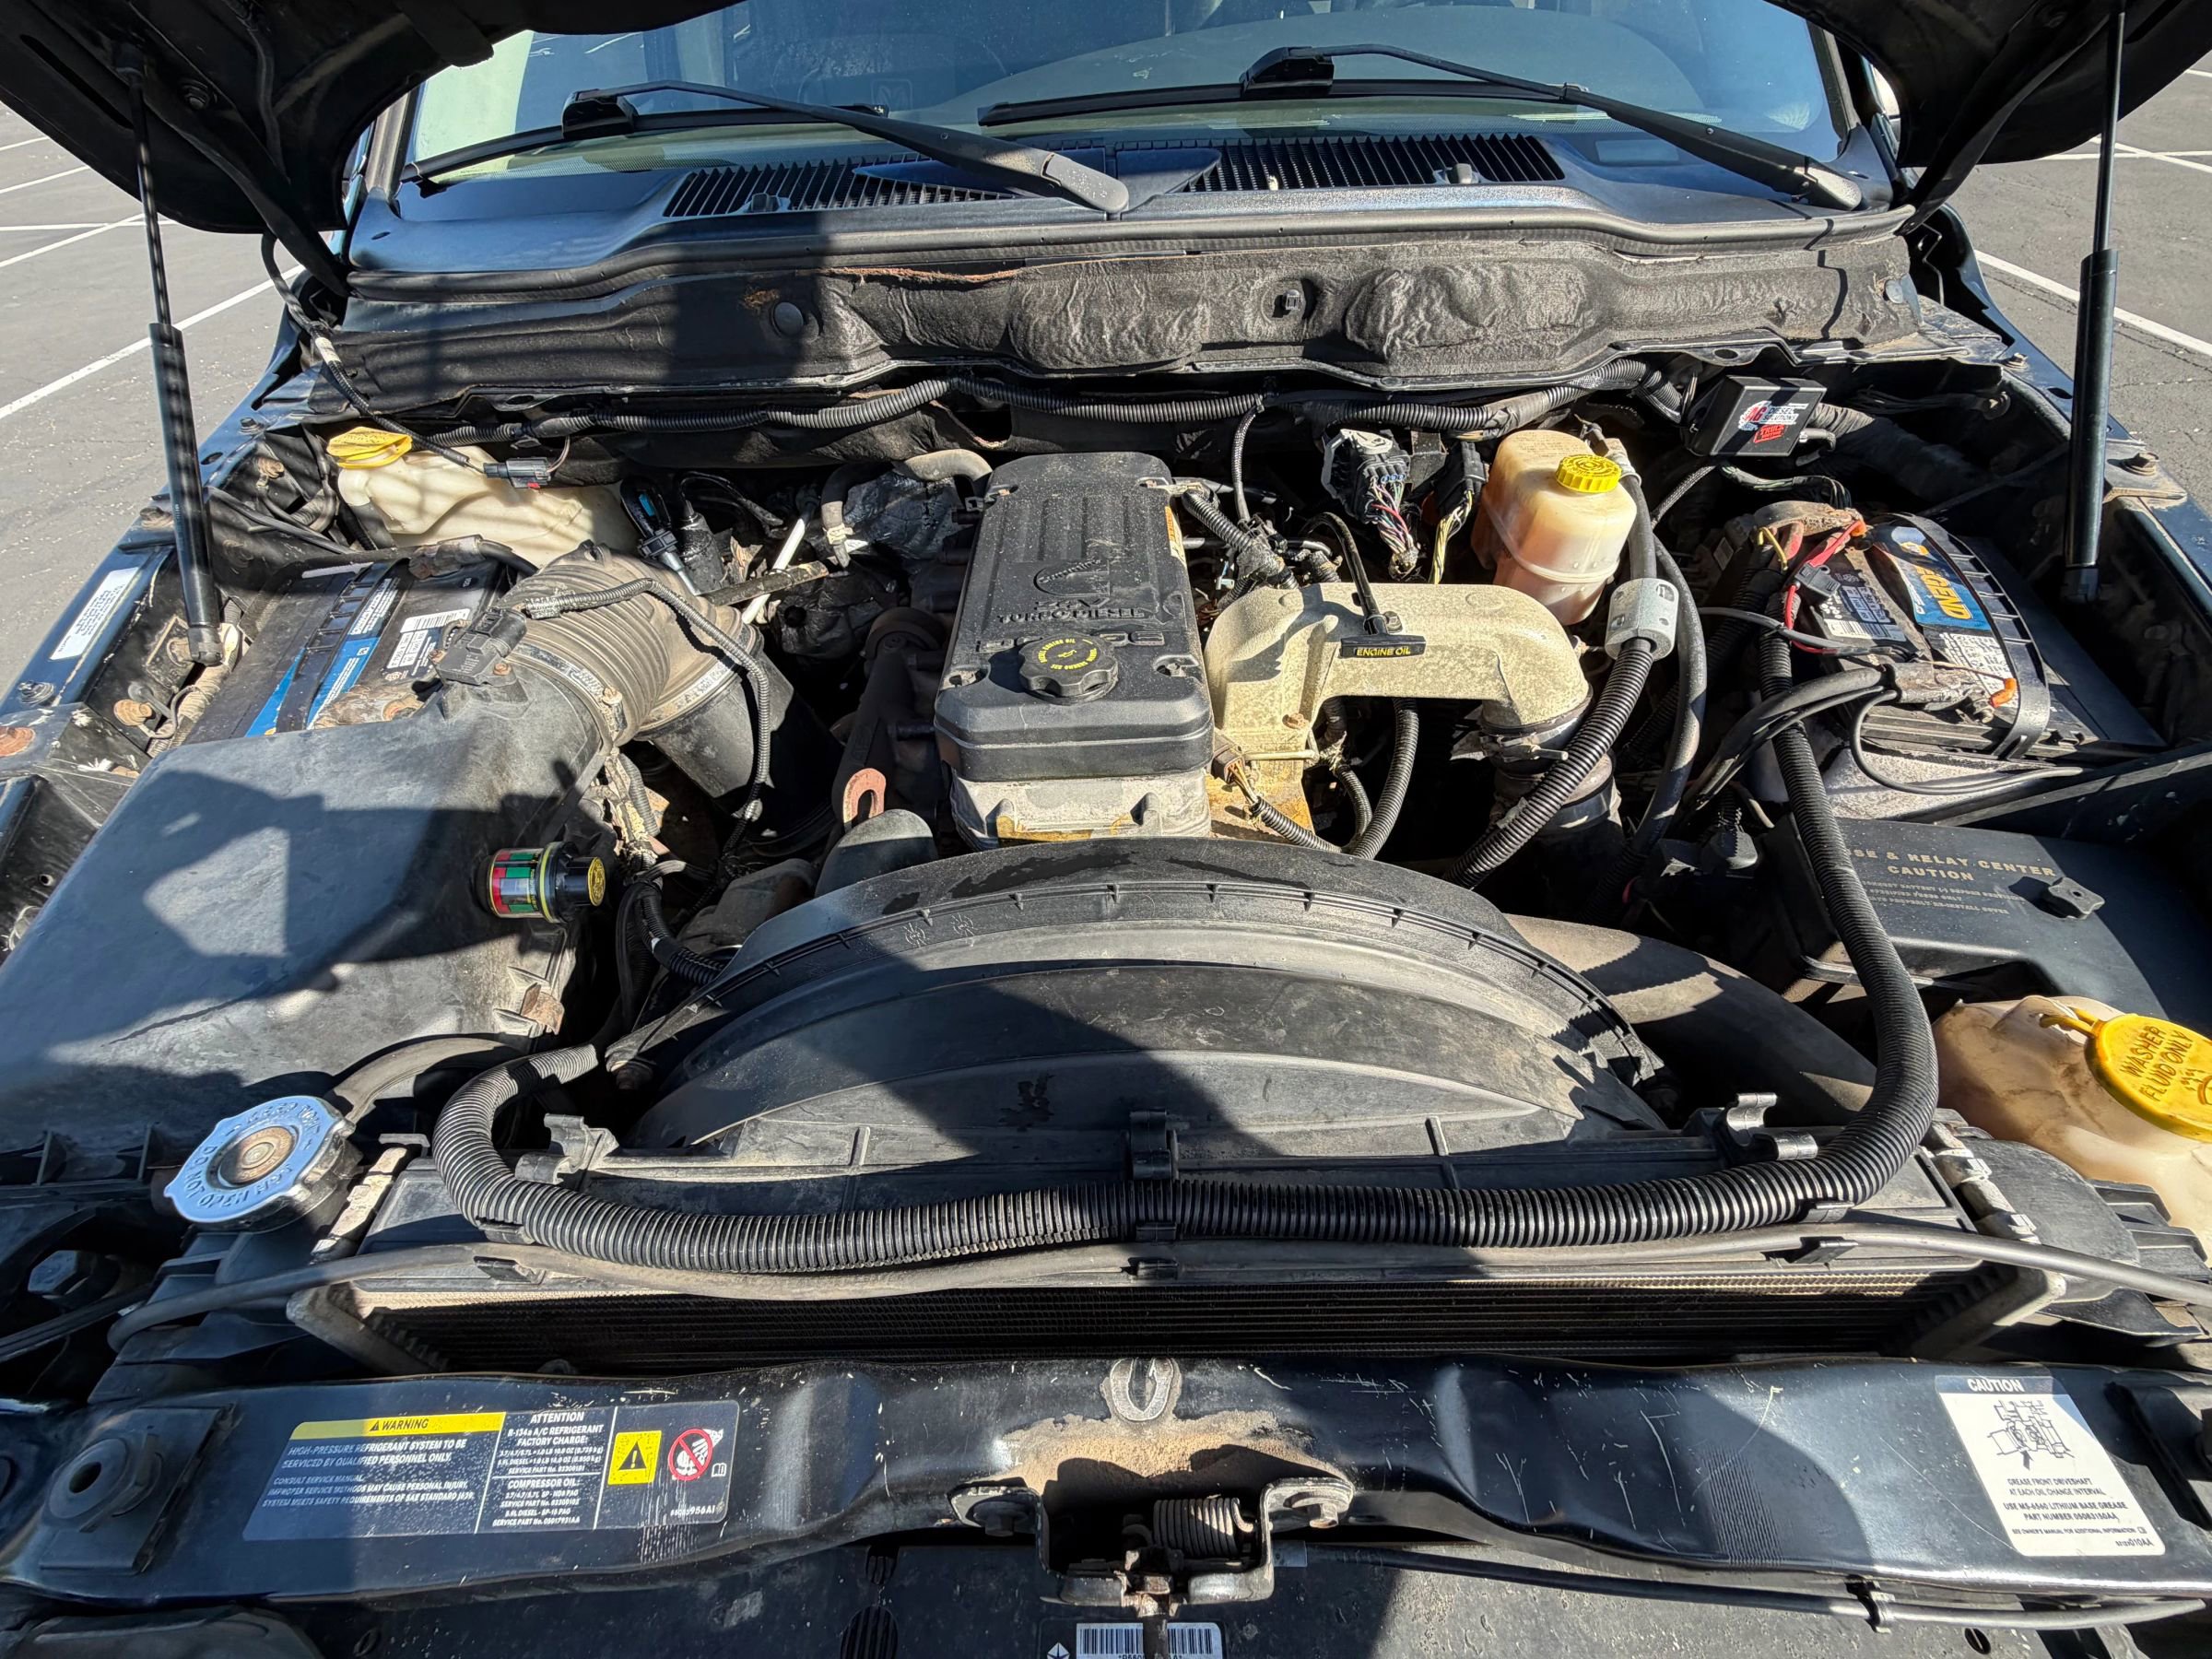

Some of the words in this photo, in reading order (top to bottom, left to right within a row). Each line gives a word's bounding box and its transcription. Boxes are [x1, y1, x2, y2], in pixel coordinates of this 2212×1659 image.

[1743, 406, 1768, 422] AG
[1357, 647, 1394, 656] ENGINE
[1394, 646, 1411, 655] OIL
[1846, 849, 1877, 858] SE
[1887, 852, 1900, 860] &
[1907, 853, 1969, 867] RELAY
[1978, 860, 2056, 877] CENTER
[1888, 865, 1974, 881] CAUTION
[2120, 1026, 2166, 1078] WASHER
[2138, 1063, 2176, 1102] FLUID
[2160, 1030, 2194, 1065] ONLY
[194, 1145, 218, 1166] DO
[186, 1171, 206, 1199] NOT
[198, 1190, 250, 1208] OPEN
[1967, 1379, 2026, 1393] CAUTION
[382, 1418, 429, 1431] WARNING
[530, 1411, 585, 1424] ATTENTION
[507, 1428, 533, 1437] R-134a
[533, 1427, 548, 1436] A/C
[549, 1424, 605, 1435] REFRIGERANT
[288, 1443, 357, 1455] HIGH-PRESSURE
[355, 1441, 411, 1453] REFRIGERANT
[409, 1440, 442, 1451] SYSTEM
[442, 1440, 454, 1450] TO
[455, 1439, 468, 1449] BE
[516, 1437, 552, 1447] FACTORY
[552, 1435, 588, 1445] CHARGE:
[281, 1457, 324, 1468] SERVICED
[323, 1457, 335, 1467] BY
[335, 1454, 379, 1467] QUALIFIED
[378, 1453, 428, 1465] PERSONNEL
[428, 1453, 453, 1464] ONLY.
[273, 1476, 306, 1485] CONSULT
[305, 1475, 334, 1484] SERVICE
[507, 1478, 562, 1489] COMPRESSOR
[562, 1477, 581, 1488] OIL:
[2006, 1477, 2031, 1486] GREASE
[2031, 1477, 2053, 1486] FRONT
[2053, 1477, 2093, 1486] DRIVESHAFT
[266, 1487, 305, 1497] IMPROPER
[304, 1486, 333, 1495] SERVICE
[367, 1483, 382, 1493] MAY
[382, 1483, 406, 1492] CAUSE
[406, 1482, 442, 1491] PERSONAL
[262, 1498, 291, 1508] SYSTEM
[290, 1497, 315, 1507] MEETS
[314, 1496, 342, 1506] SAFETY
[341, 1494, 394, 1505] REQUIREMENTS
[394, 1494, 406, 1503] OF
[406, 1493, 420, 1502] SAE
[419, 1491, 457, 1501] STANDARD
[2003, 1502, 2018, 1511] USE
[2078, 1501, 2099, 1510] BASE
[2098, 1501, 2128, 1510] GREASE
[517, 1517, 533, 1525] PART
